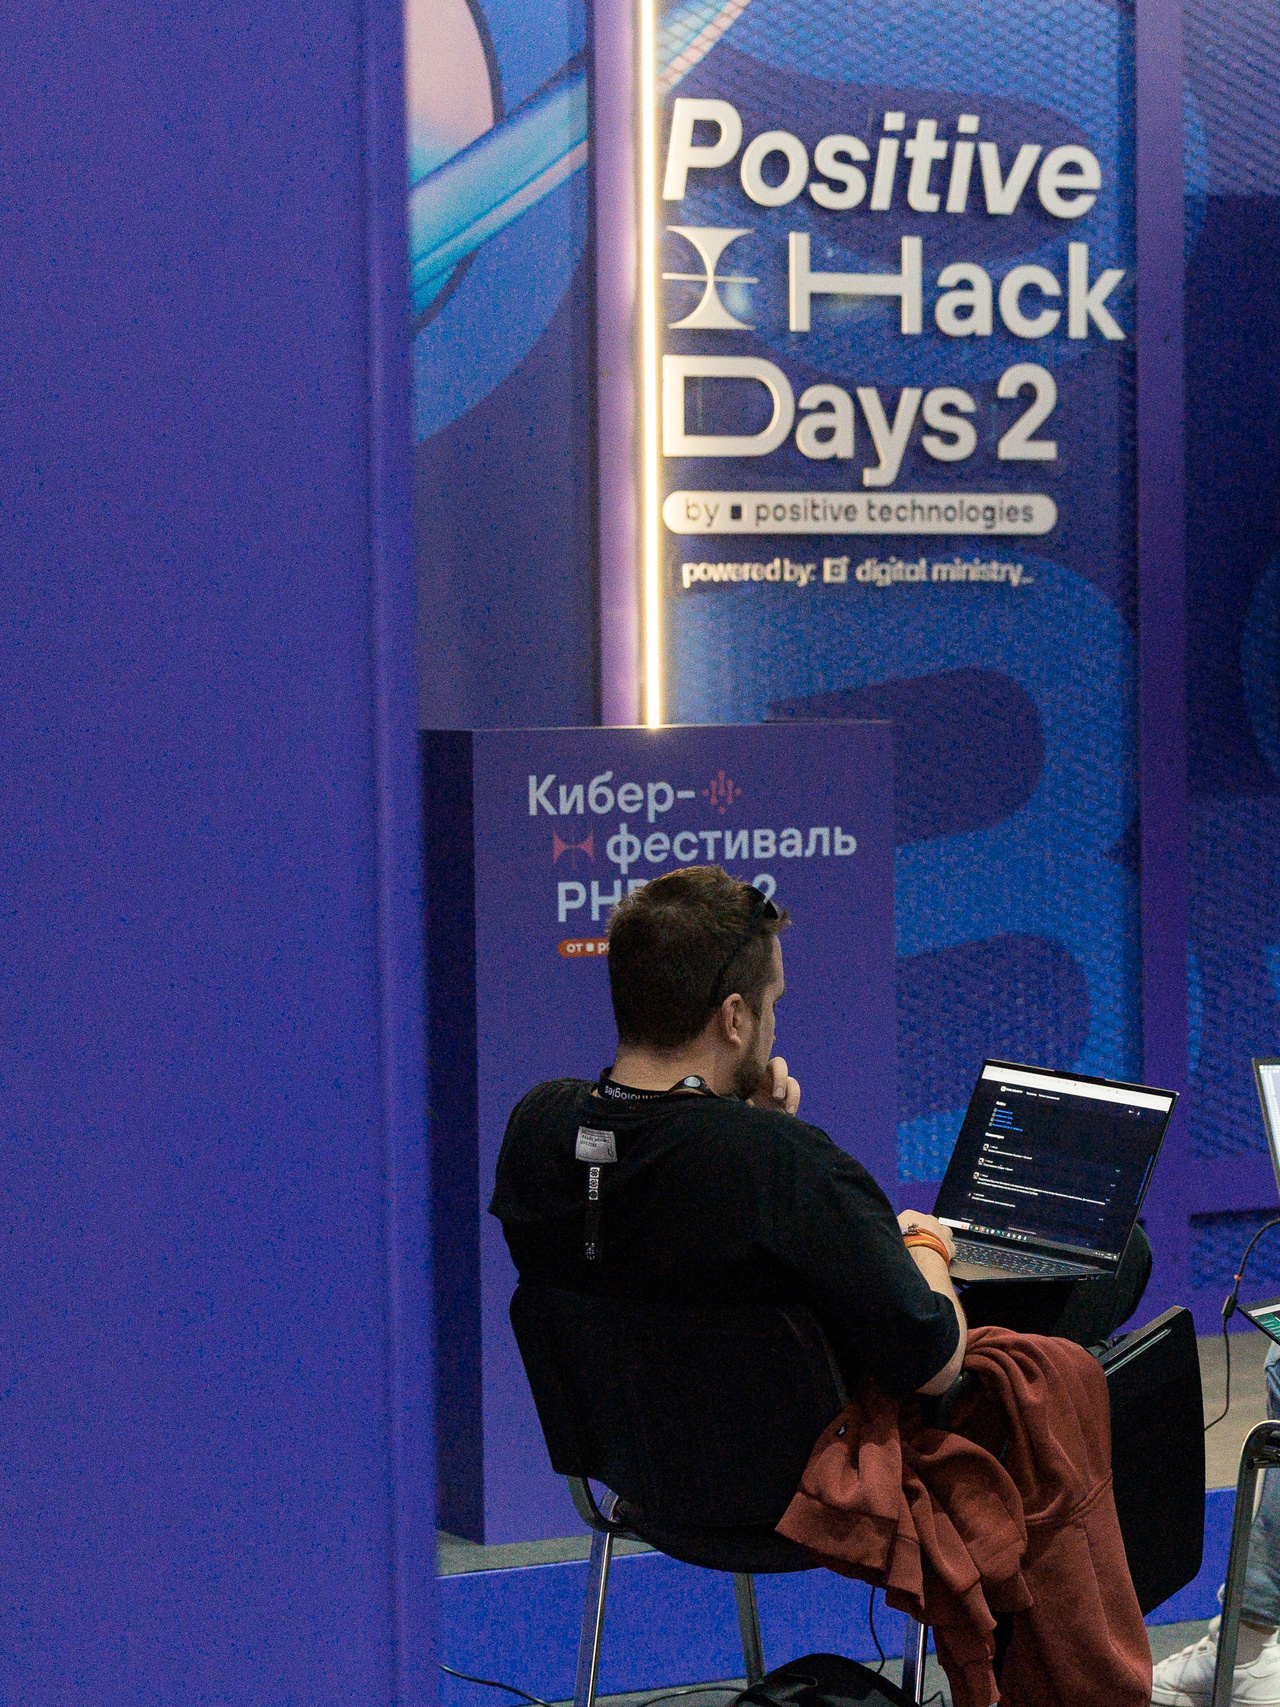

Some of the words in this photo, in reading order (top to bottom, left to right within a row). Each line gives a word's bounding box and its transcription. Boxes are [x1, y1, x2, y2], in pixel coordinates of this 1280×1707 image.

[662, 98, 1102, 219] Positive
[788, 231, 1127, 340] Hack
[662, 354, 979, 487] Days
[996, 363, 1058, 461] 2
[685, 498, 719, 527] by
[755, 499, 858, 527] positive
[866, 499, 1035, 529] technologies
[682, 558, 781, 588] powered
[855, 556, 928, 587] digital
[528, 771, 696, 823] Кибер-
[605, 823, 858, 875] фестиваль
